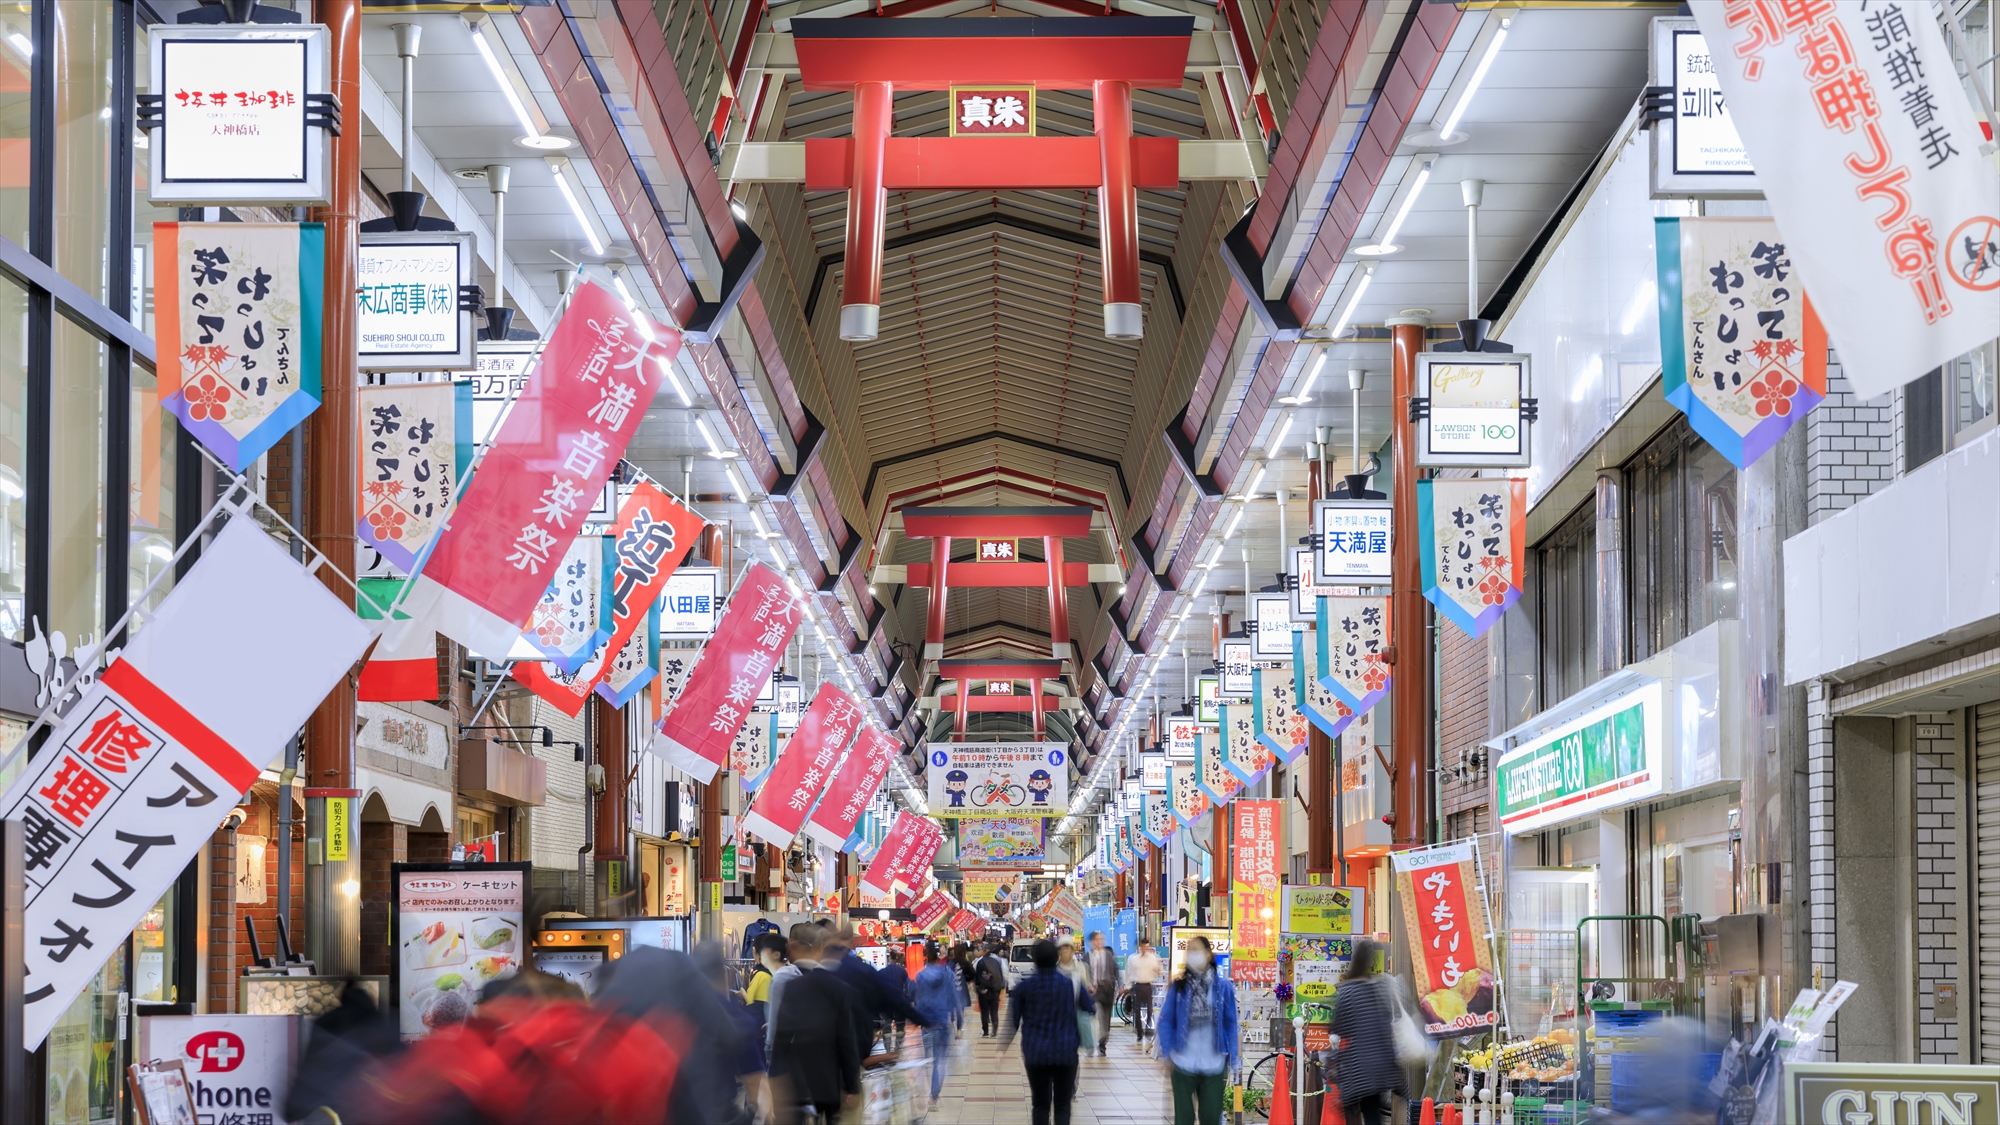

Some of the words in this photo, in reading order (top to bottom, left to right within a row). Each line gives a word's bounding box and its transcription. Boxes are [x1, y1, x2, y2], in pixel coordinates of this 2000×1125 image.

[210, 124, 260, 136] 天神橋店
[363, 334, 394, 342] SUEHIRO
[397, 334, 418, 342] SHOJI
[1692, 321, 1705, 379] てんさん
[1709, 260, 1745, 390] わっしょい
[1440, 432, 1471, 440] STORE
[1481, 424, 1516, 440] 100
[1329, 531, 1387, 553] 天満屋
[1452, 506, 1475, 590] わっしょい
[1478, 493, 1503, 556] 笑って
[660, 595, 710, 613] 八田屋
[709, 589, 799, 735] 天満音楽祭
[788, 702, 861, 811] 天満音楽祭
[840, 737, 896, 823] 天満音楽祭
[333, 801, 342, 852] 防犯カメラ作動中
[462, 881, 518, 890] ケーキセット
